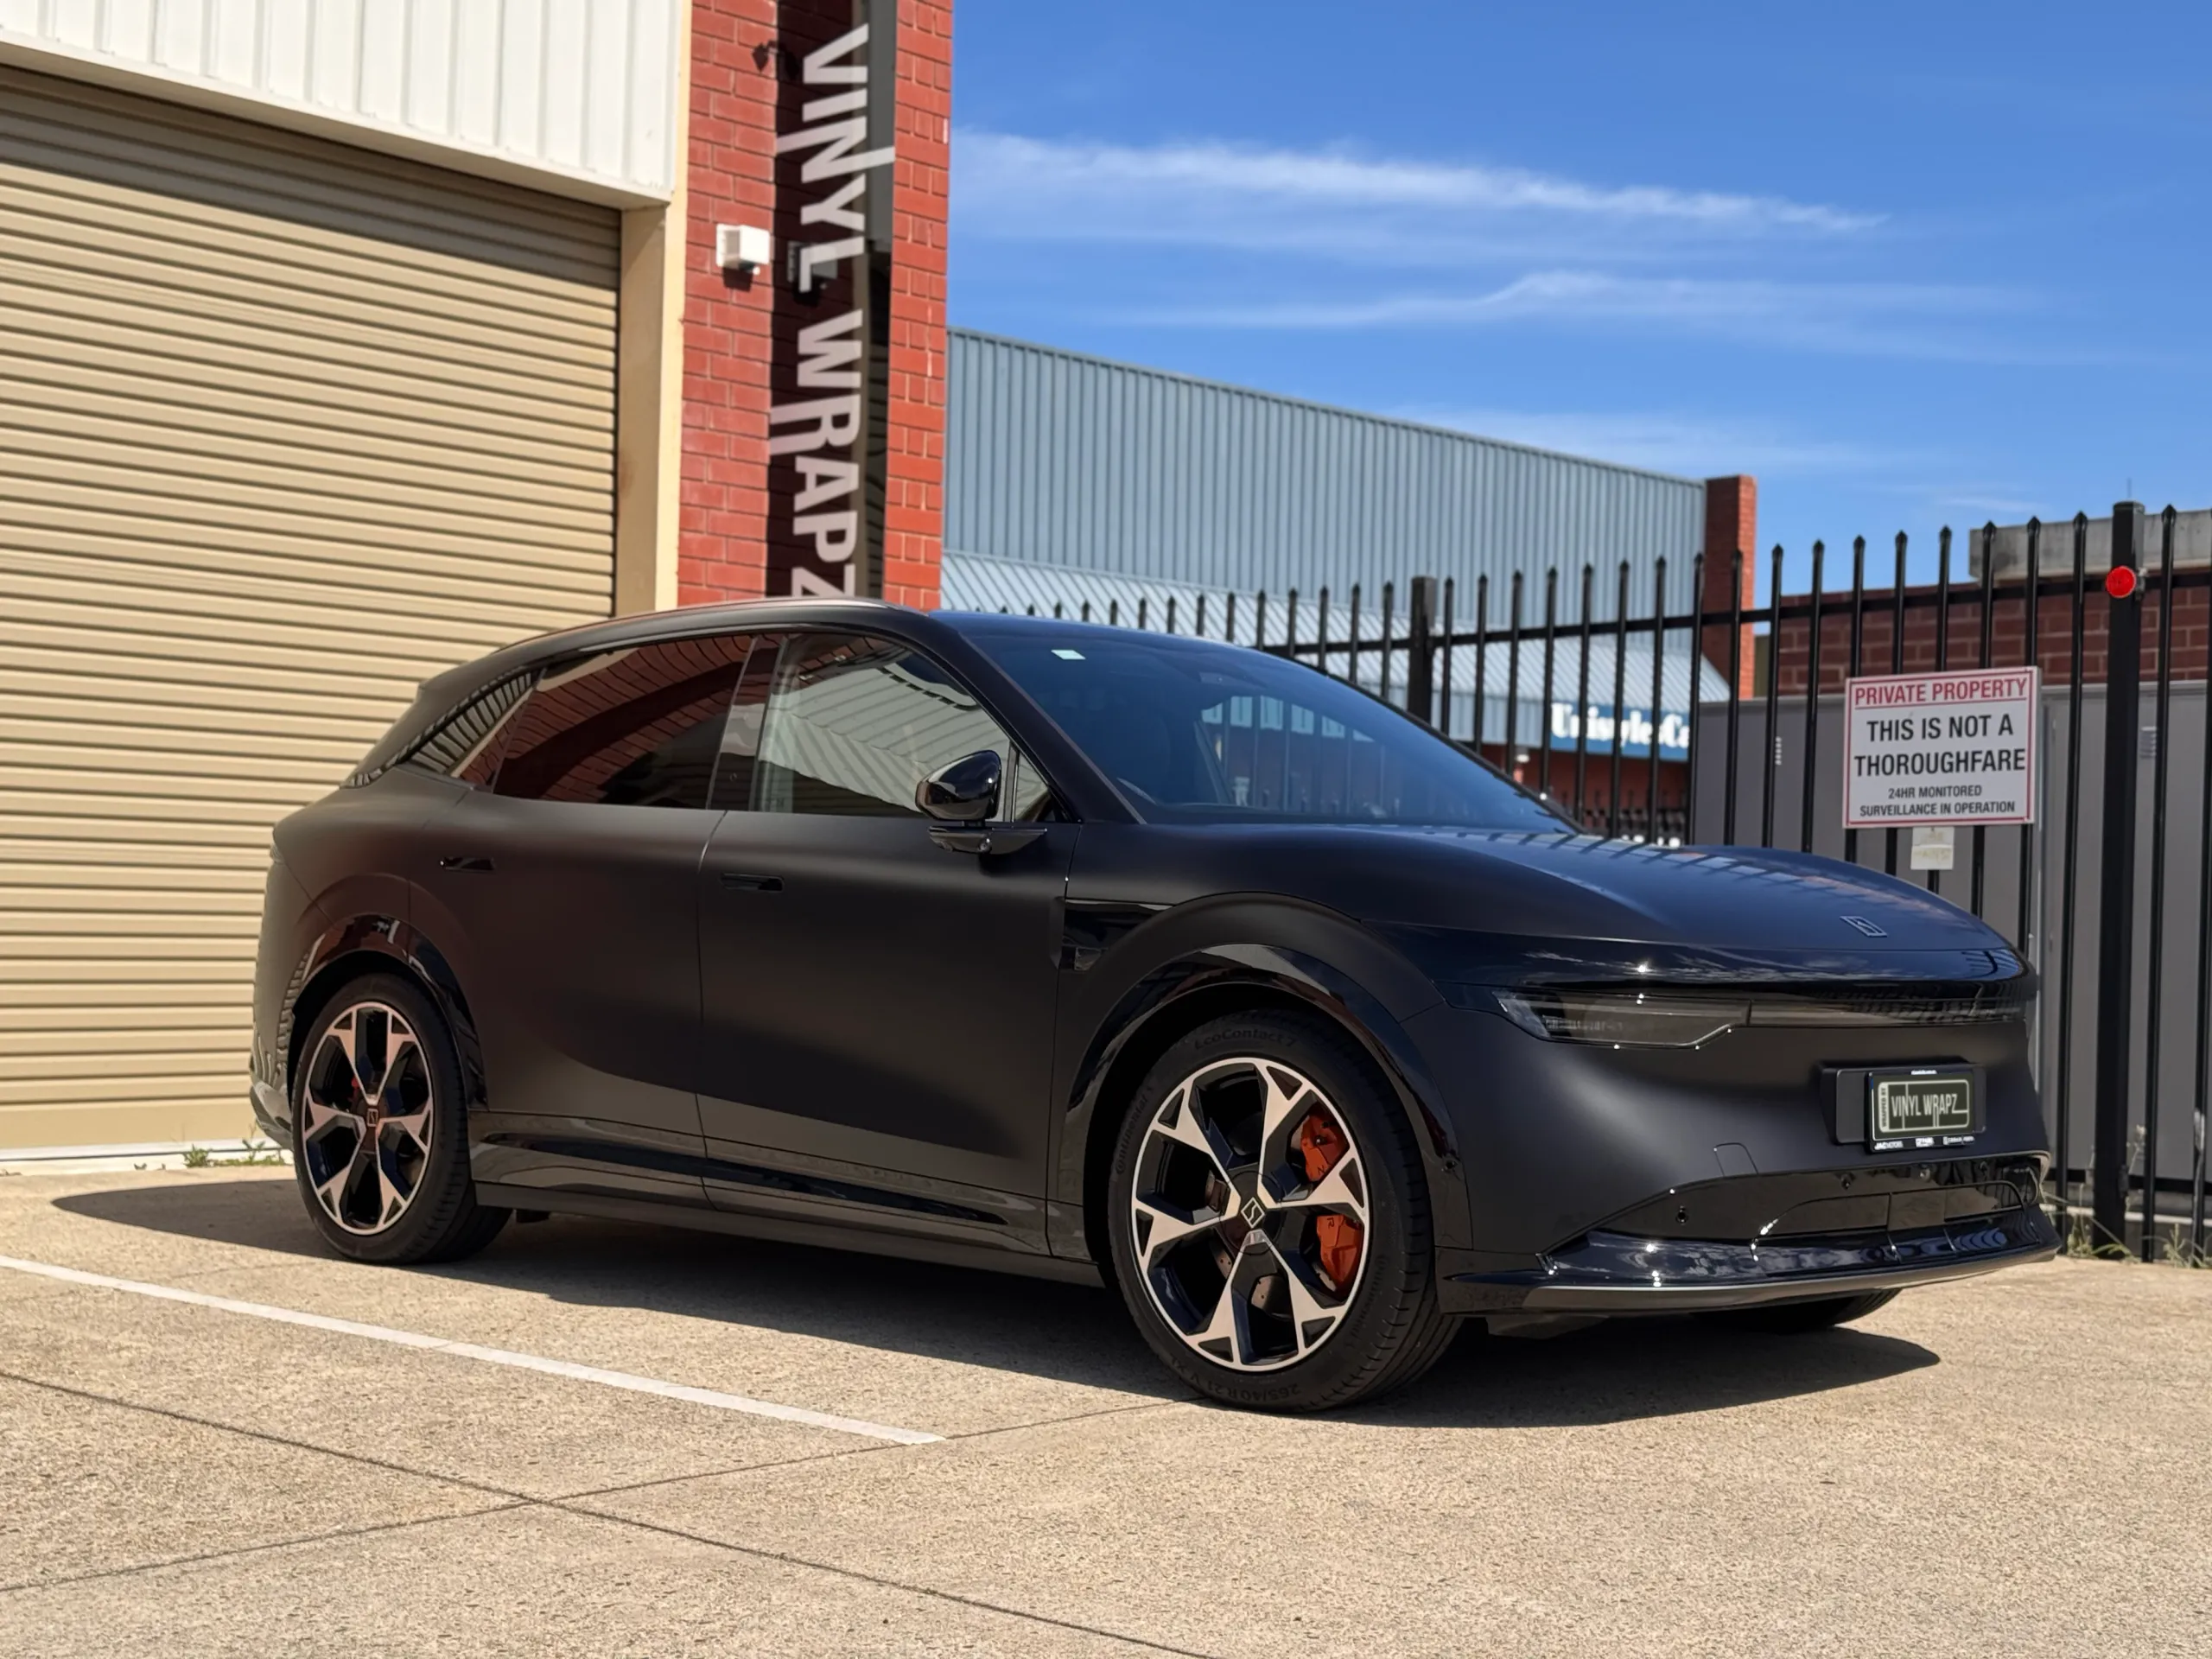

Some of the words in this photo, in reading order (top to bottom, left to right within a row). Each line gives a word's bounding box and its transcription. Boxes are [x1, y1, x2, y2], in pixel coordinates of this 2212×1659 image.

[777, 22, 895, 293] VINYL
[1855, 683, 1927, 705] PRIVATE
[1932, 677, 2027, 702] PROPERTY
[1867, 718, 1914, 742] THIS
[1922, 717, 1941, 740] IS
[1948, 715, 1992, 739] NOT
[1998, 714, 2013, 736] A
[1854, 748, 2026, 777] THOROUGHFARE
[1888, 786, 1916, 799] 24HR
[1918, 785, 1982, 798] MONITORED
[1859, 803, 1937, 817] SURVEILLANCE
[1940, 803, 1951, 815] IN
[1955, 801, 2016, 814] OPERATION
[1923, 1094, 1967, 1127] WRAPZ
